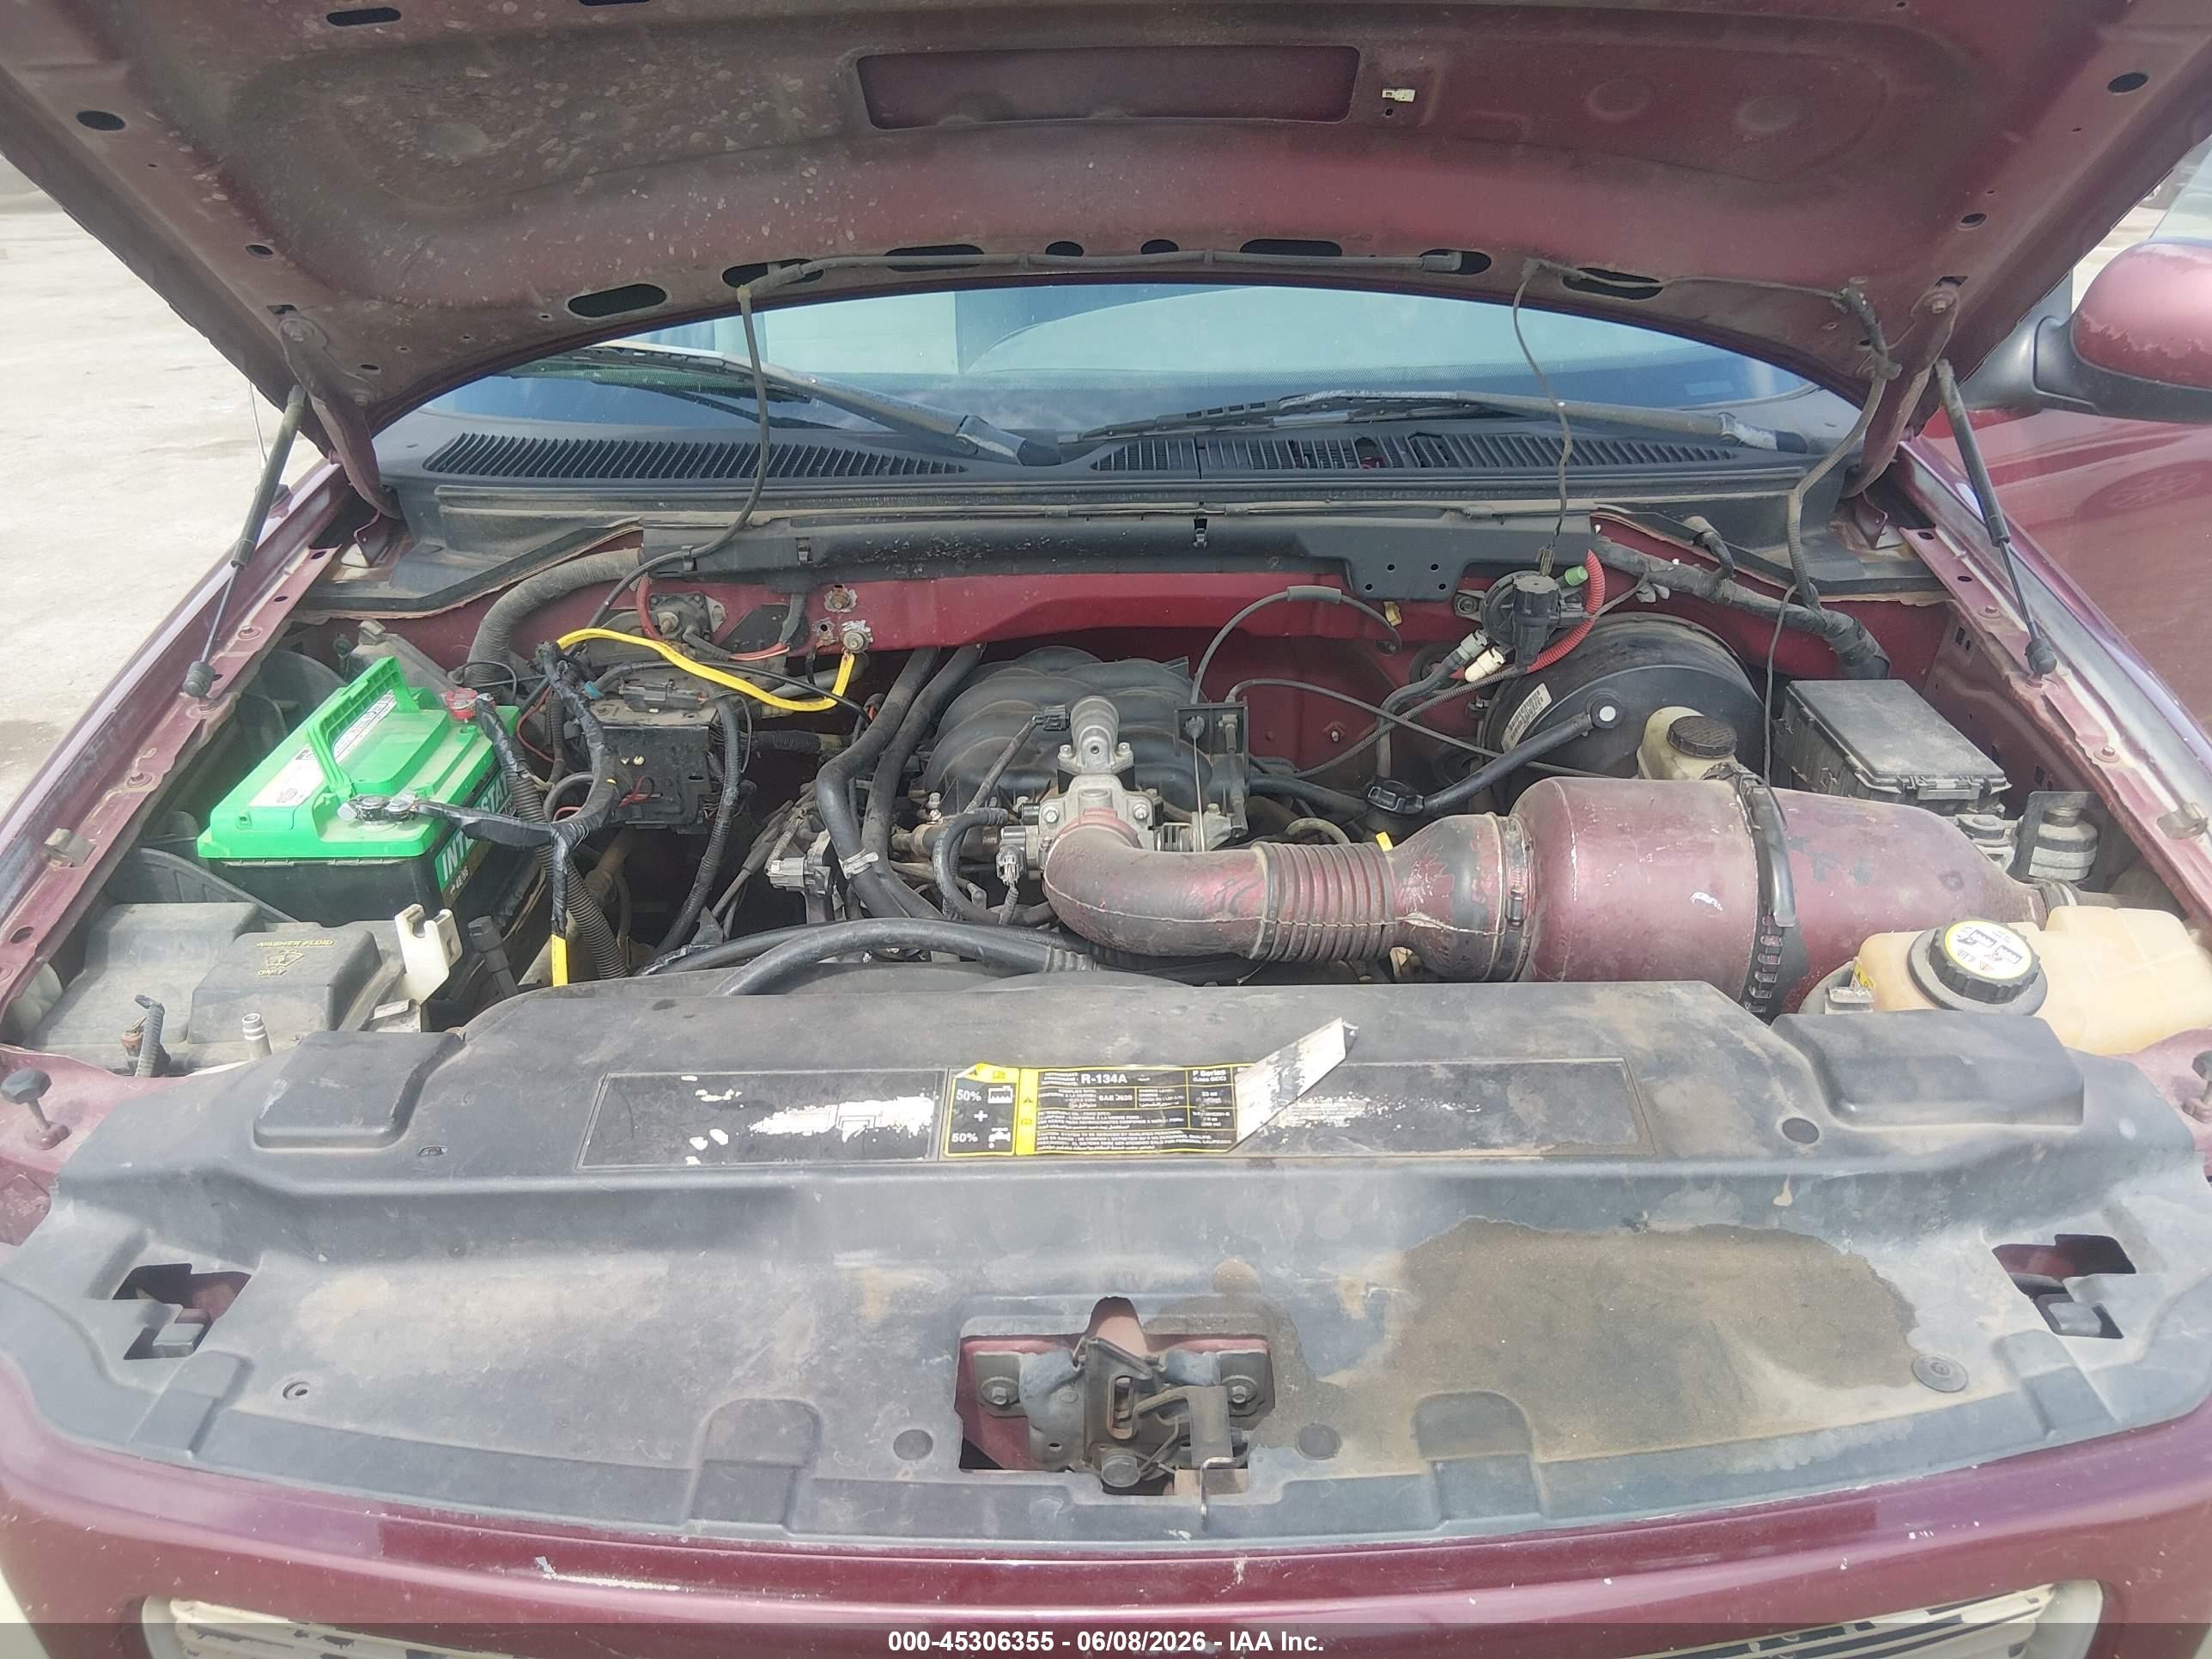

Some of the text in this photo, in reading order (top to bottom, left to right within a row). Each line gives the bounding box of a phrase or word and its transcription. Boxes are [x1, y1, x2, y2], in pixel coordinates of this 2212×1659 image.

[1081, 1073, 1127, 1085] R-134A
[956, 1089, 981, 1102] 50%
[951, 1133, 978, 1143] 50%
